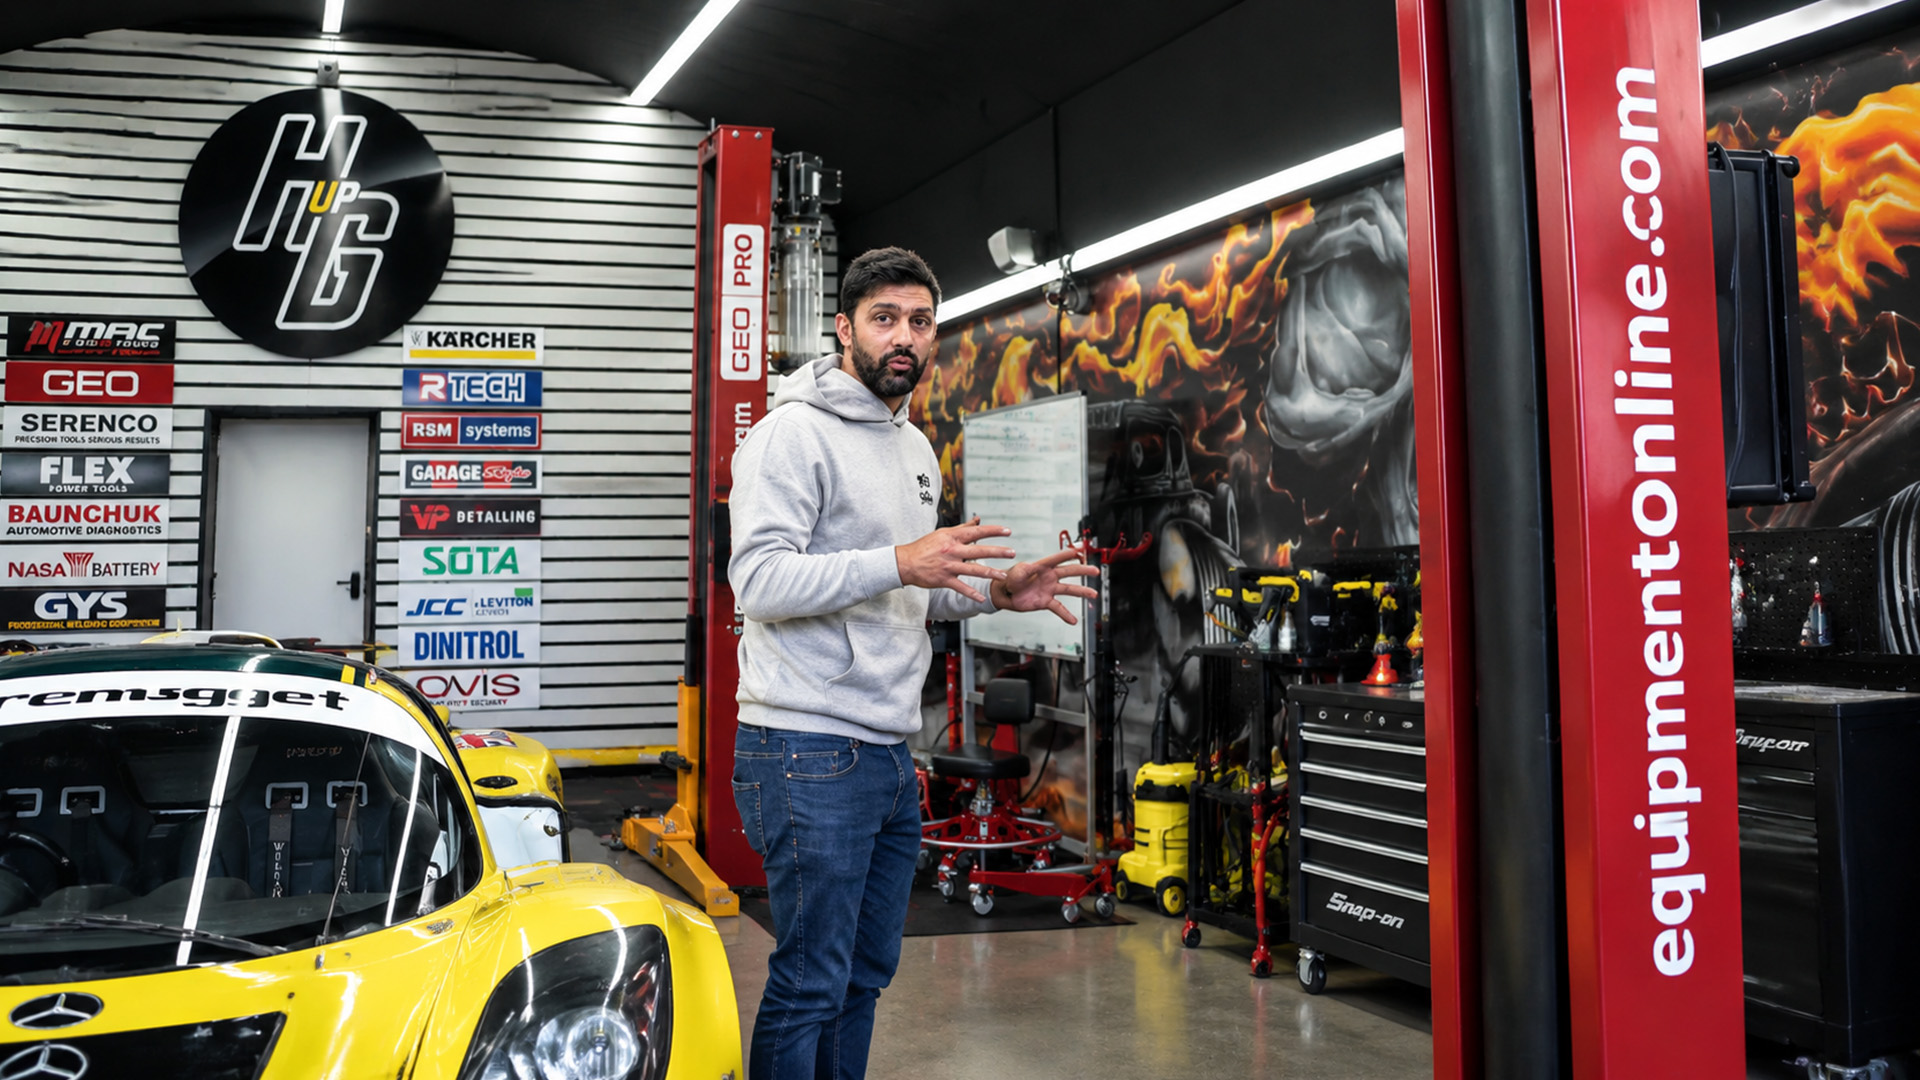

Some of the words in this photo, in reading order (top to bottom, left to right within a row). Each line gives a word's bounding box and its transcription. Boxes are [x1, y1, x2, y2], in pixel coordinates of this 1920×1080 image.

[733, 233, 753, 287] PRO
[63, 321, 165, 341] MAC
[427, 330, 536, 349] KÄRCHER
[731, 307, 751, 373] GEO
[42, 369, 140, 397] GEO
[20, 413, 158, 433] SERENCO
[412, 422, 452, 437] RSM
[465, 422, 532, 441] systems
[40, 456, 135, 484] FLEX
[411, 464, 481, 481] GARAGE
[49, 484, 88, 493] POWER
[93, 484, 128, 493] TOOLS
[8, 504, 161, 523] BAUNCHUK
[409, 504, 451, 531] VP
[1613, 66, 1706, 977] equipmentonline.com
[6, 525, 83, 536] AUTOMOTIVE
[8, 561, 66, 578] NASA
[92, 561, 161, 578] BATTERY
[422, 546, 520, 576] SOTA
[33, 591, 128, 620] GYS
[406, 598, 467, 617] JCC
[414, 630, 525, 661] DINITROL
[1326, 890, 1405, 930] Snap-on
